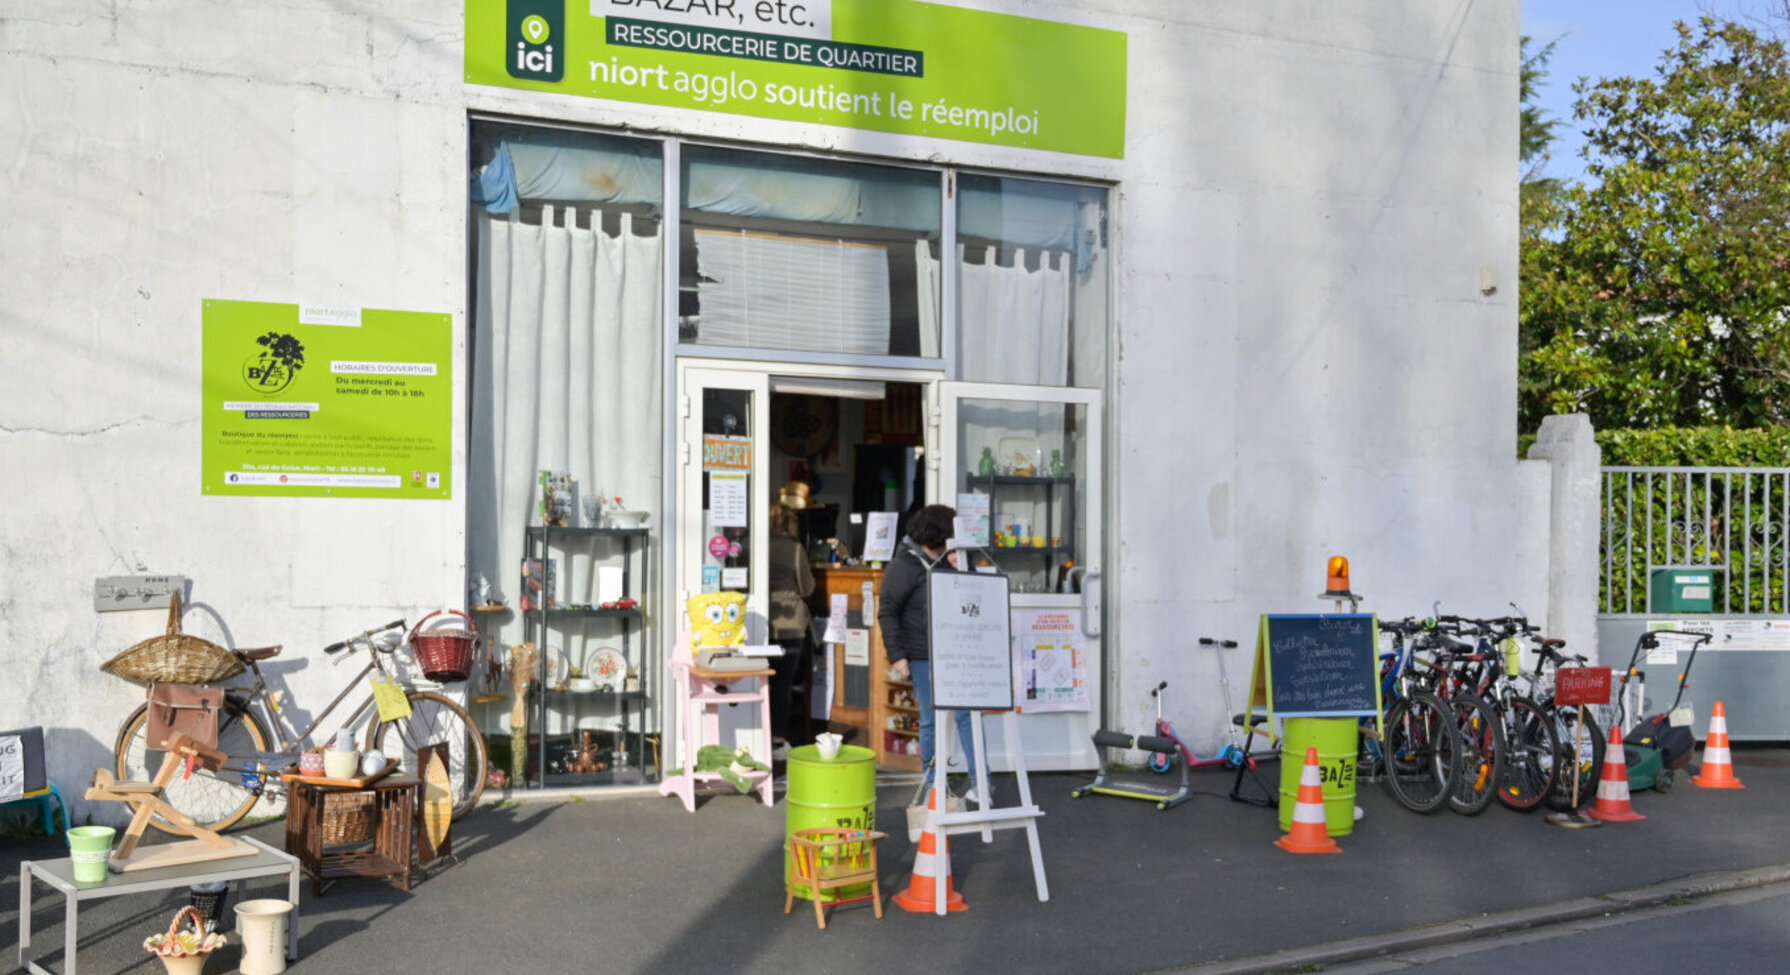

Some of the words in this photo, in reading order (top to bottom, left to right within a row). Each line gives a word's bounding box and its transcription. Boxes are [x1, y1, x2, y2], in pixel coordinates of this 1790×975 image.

[755, 0, 815, 27] etc.
[517, 41, 553, 73] ici
[614, 23, 777, 59] RESSOURCERIE
[784, 43, 812, 62] DE
[817, 46, 917, 73] QUARTIER
[764, 83, 881, 117] soutient
[891, 92, 913, 120] le
[922, 98, 1038, 136] réemploi
[334, 364, 377, 372] HORAIRES
[336, 376, 346, 384] Du
[351, 377, 392, 386] mercredi
[336, 387, 369, 395] samedi
[385, 388, 400, 396] 10h
[410, 389, 425, 397] 18h
[222, 431, 255, 439] Boutique
[703, 441, 749, 466] OUVERT
[1562, 676, 1605, 690] PARKING
